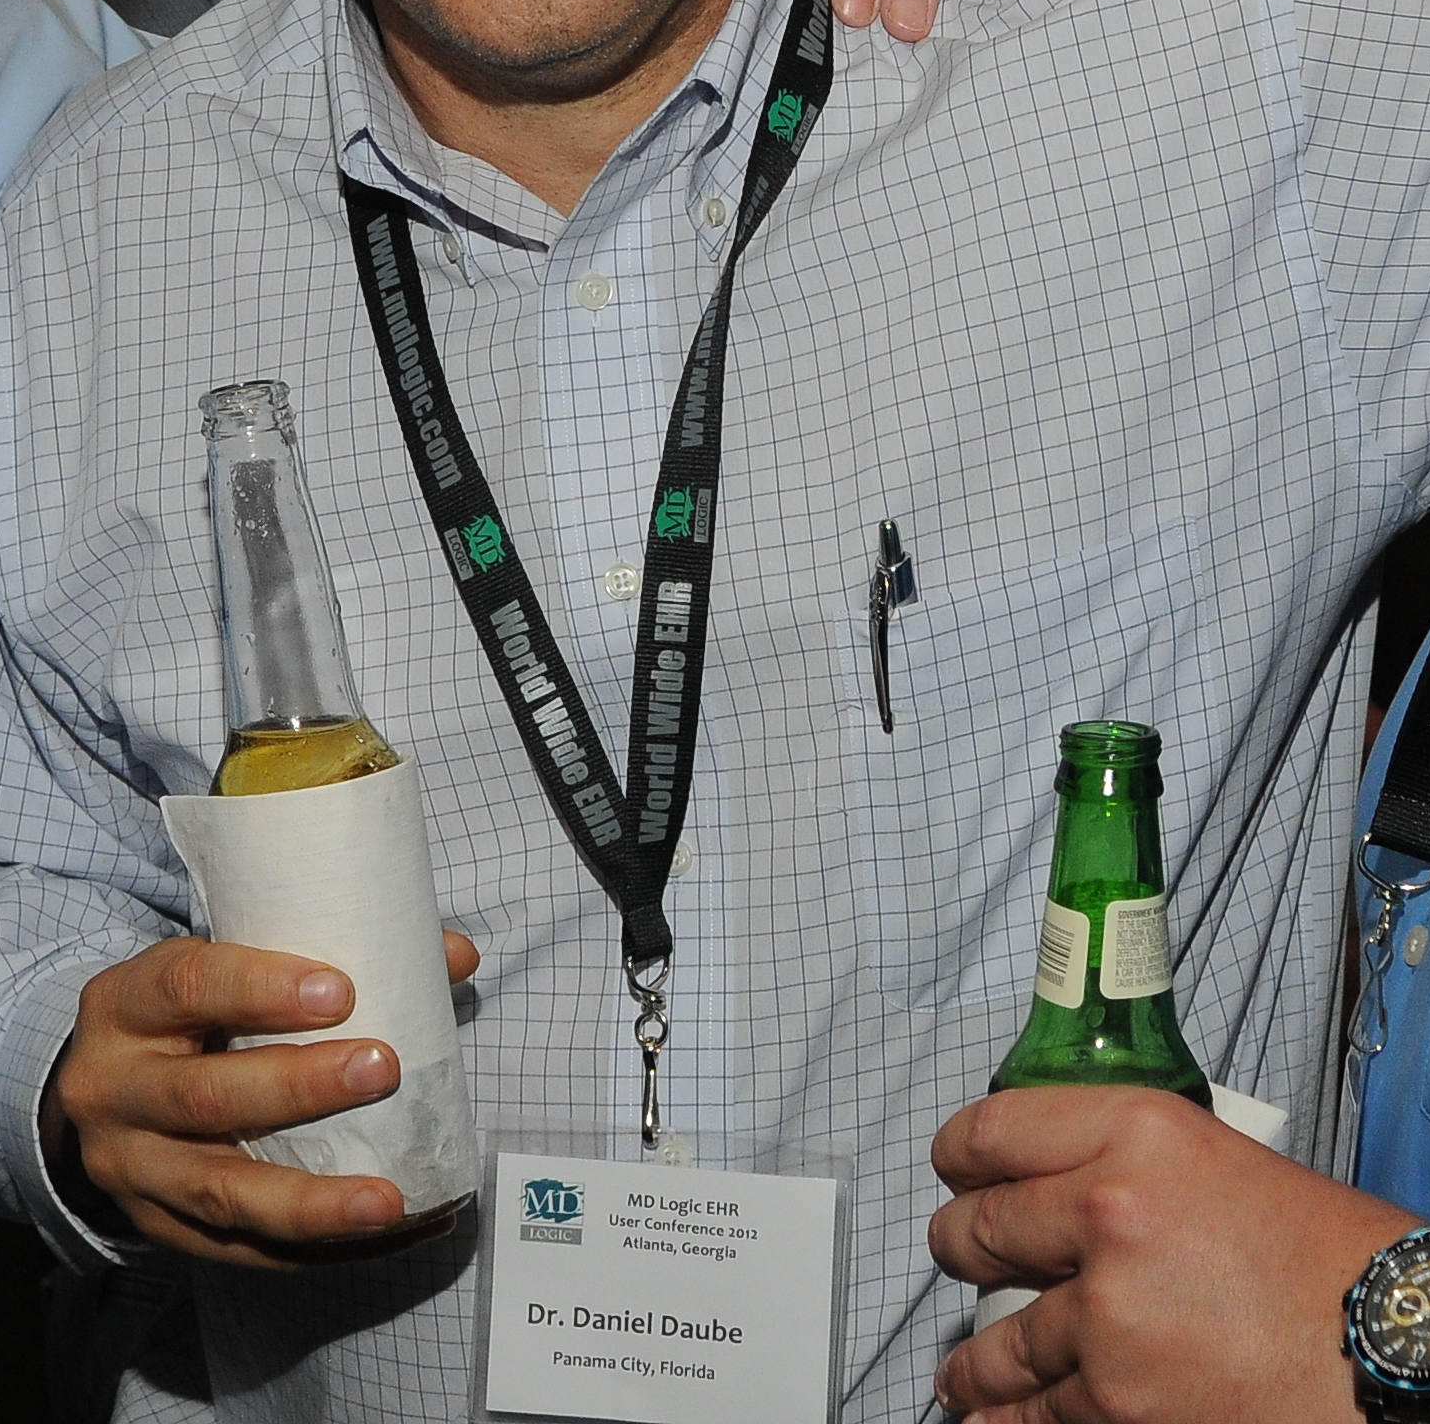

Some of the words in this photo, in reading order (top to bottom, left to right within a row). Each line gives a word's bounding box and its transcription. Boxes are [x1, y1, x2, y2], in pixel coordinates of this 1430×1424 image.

[774, 89, 802, 142] MD
[792, 107, 815, 153] LOGIC
[366, 213, 464, 491] www.mdlogic.com
[664, 489, 688, 538] MD
[696, 494, 711, 538] LOGIC
[448, 531, 471, 573] LOGIC
[470, 519, 503, 565] MD
[654, 580, 693, 643] EHR
[646, 649, 687, 736] Wide
[489, 599, 557, 704] World
[532, 696, 589, 786] Wide
[571, 782, 622, 848] EHR
[637, 743, 678, 845] World
[524, 1186, 582, 1216] MD
[627, 1193, 656, 1210] MD
[660, 1196, 702, 1217] Logic
[706, 1201, 740, 1218] EHR
[529, 1227, 573, 1242] LOGIC
[609, 1213, 641, 1228] User
[644, 1217, 725, 1238] Conference
[728, 1227, 759, 1241] 2012
[623, 1235, 678, 1256] Atlanta,
[681, 1241, 737, 1262] Georgia
[527, 1303, 565, 1327] Dr.
[572, 1306, 653, 1335] Daniel
[661, 1316, 743, 1345] Daube
[553, 1351, 616, 1370] Panama
[621, 1356, 656, 1377] City,
[659, 1360, 715, 1381] Florida
